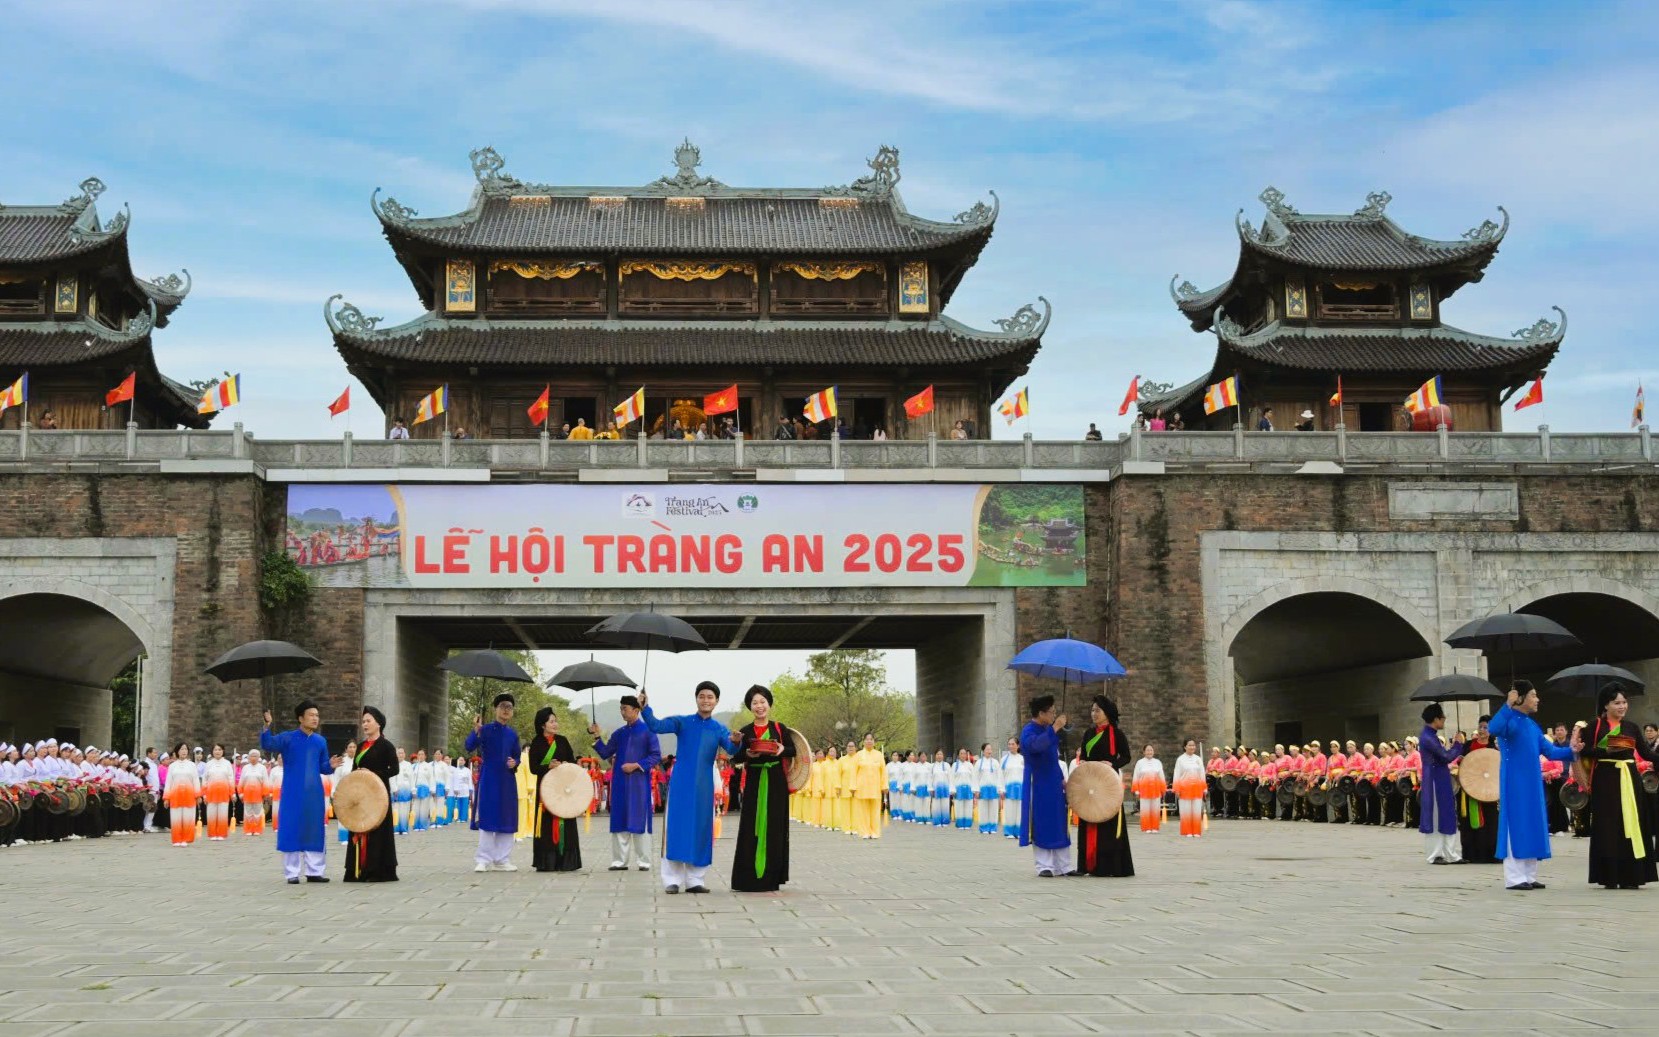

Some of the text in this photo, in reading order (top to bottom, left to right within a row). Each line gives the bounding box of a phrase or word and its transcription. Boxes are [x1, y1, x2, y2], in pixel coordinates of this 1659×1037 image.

[666, 506, 703, 516] Festival
[415, 520, 964, 582] LỄ HỘI TRÀNG AN 2025
